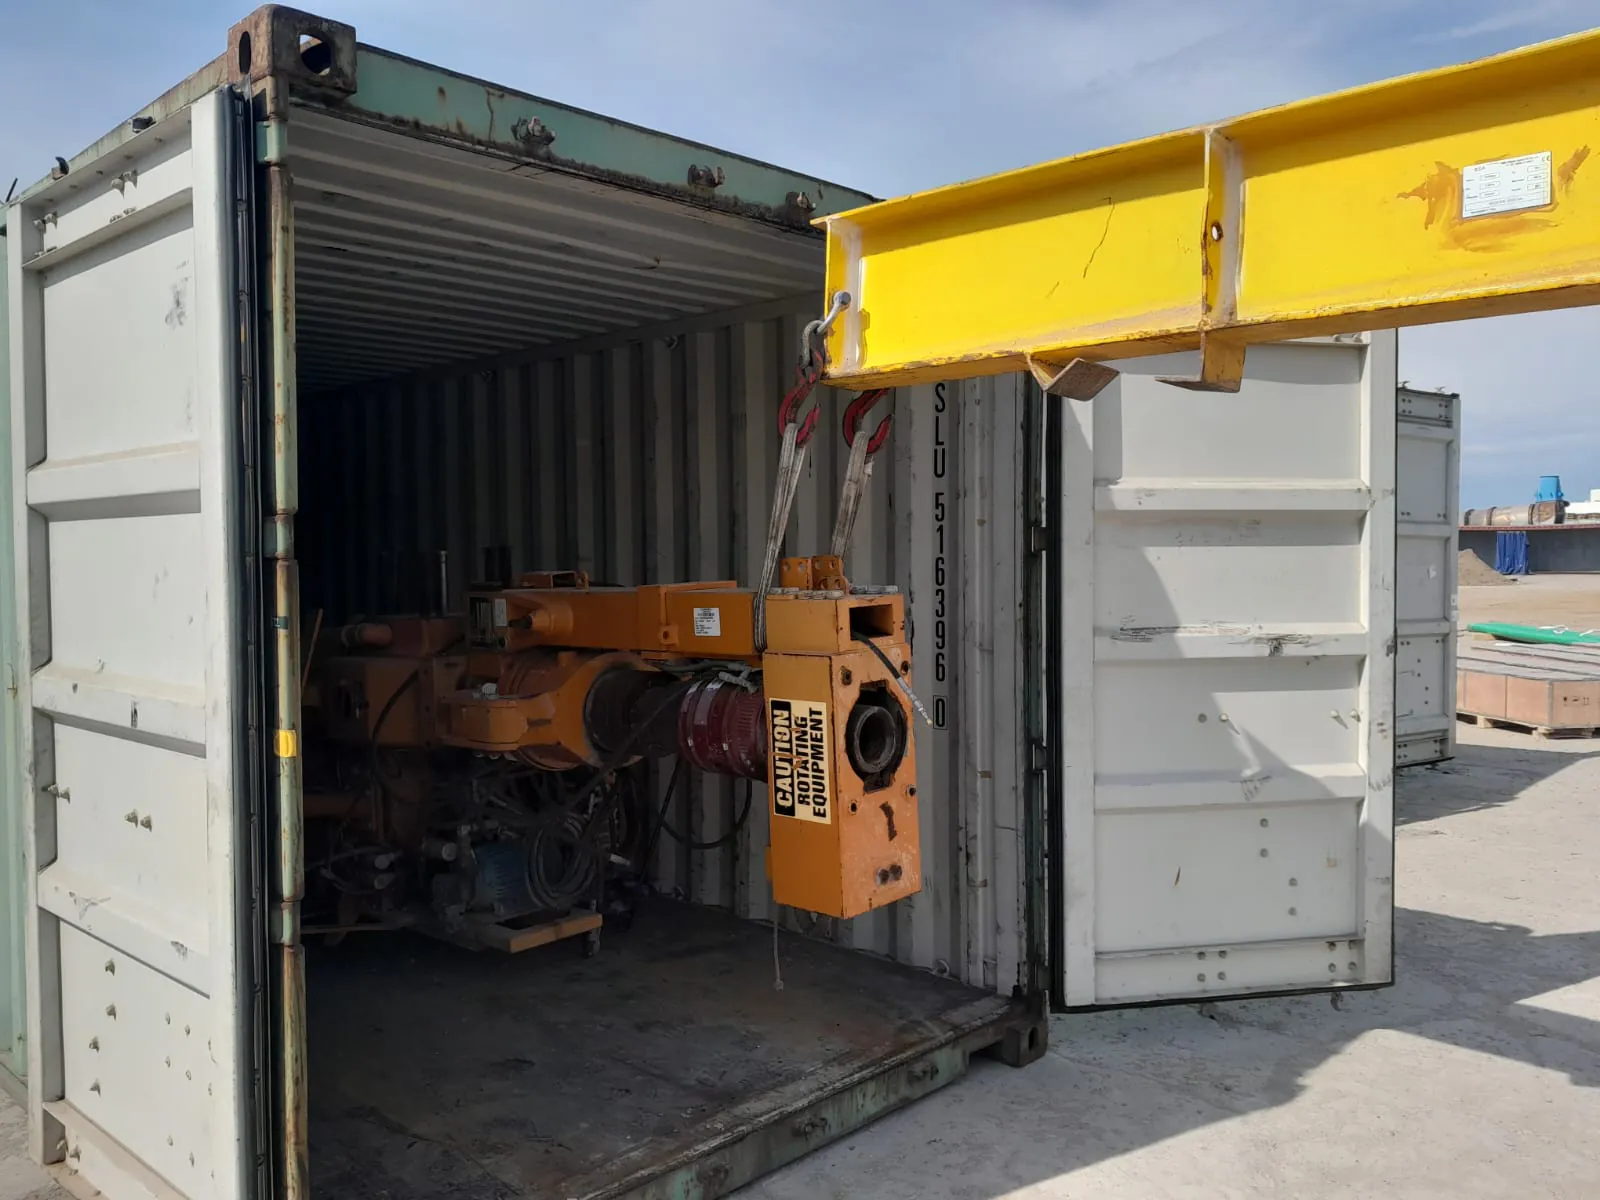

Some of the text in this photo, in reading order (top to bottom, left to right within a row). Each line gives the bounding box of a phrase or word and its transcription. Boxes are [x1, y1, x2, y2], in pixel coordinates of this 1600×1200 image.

[933, 382, 946, 478] SLU
[935, 492, 946, 682] 516396
[773, 709, 794, 807] CAUTION
[794, 716, 811, 806] ROTATING
[809, 707, 827, 818] EQUIPMENT
